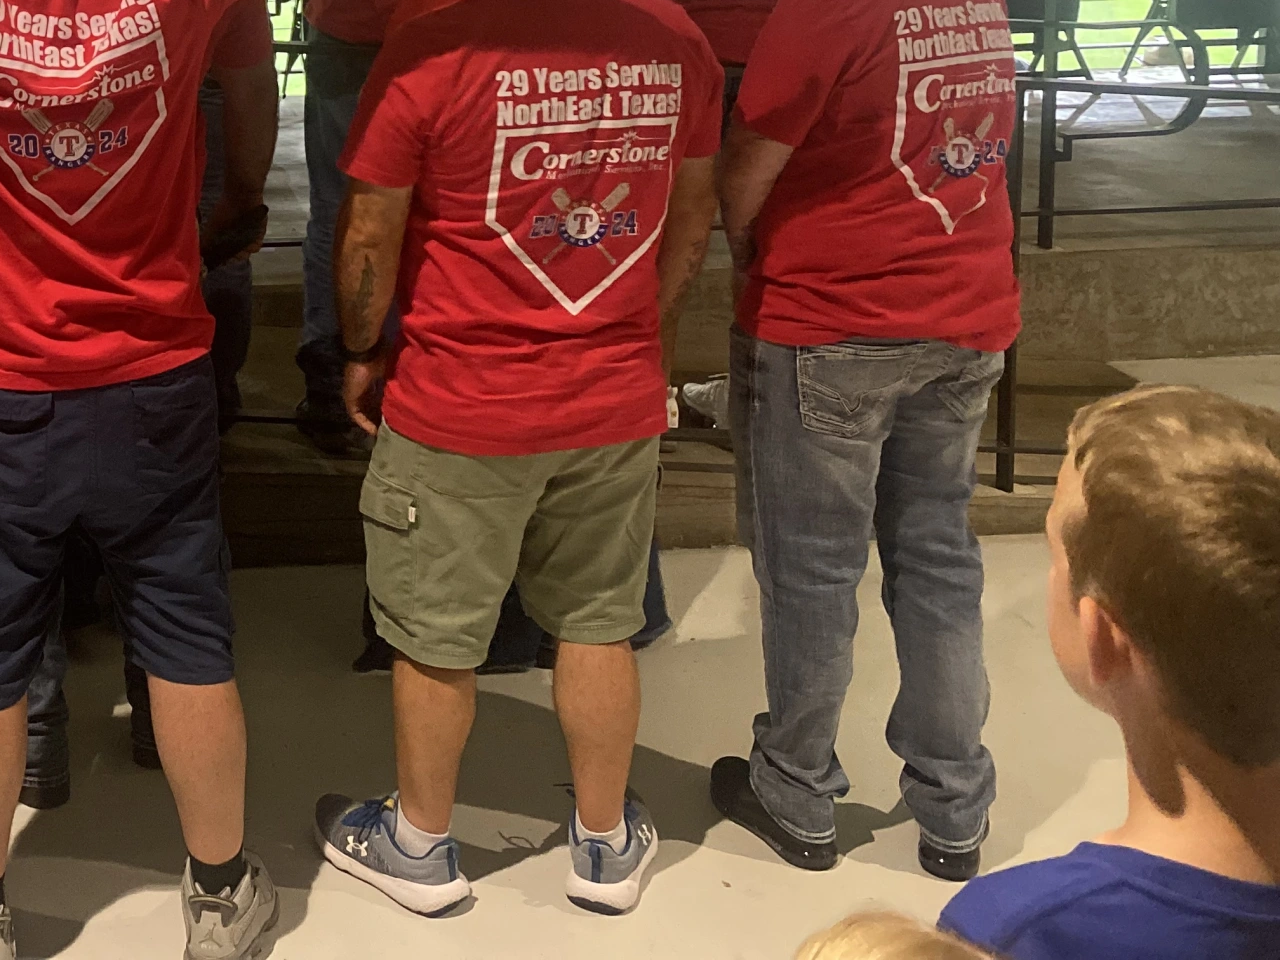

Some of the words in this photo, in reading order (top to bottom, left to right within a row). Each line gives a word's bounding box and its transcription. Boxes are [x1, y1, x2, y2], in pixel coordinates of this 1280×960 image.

[7, 2, 72, 40] Years
[894, 8, 922, 35] 29
[922, 5, 966, 29] Years
[495, 70, 529, 97] 29
[533, 68, 602, 93] Years
[605, 60, 682, 88] Serving
[497, 93, 612, 127] NorthEast
[619, 89, 681, 116] Texas!
[8, 134, 39, 159] 20
[99, 126, 128, 154] 24
[45, 148, 94, 168] RANGERS
[510, 141, 669, 180] Cornerstone
[611, 210, 637, 236] 24
